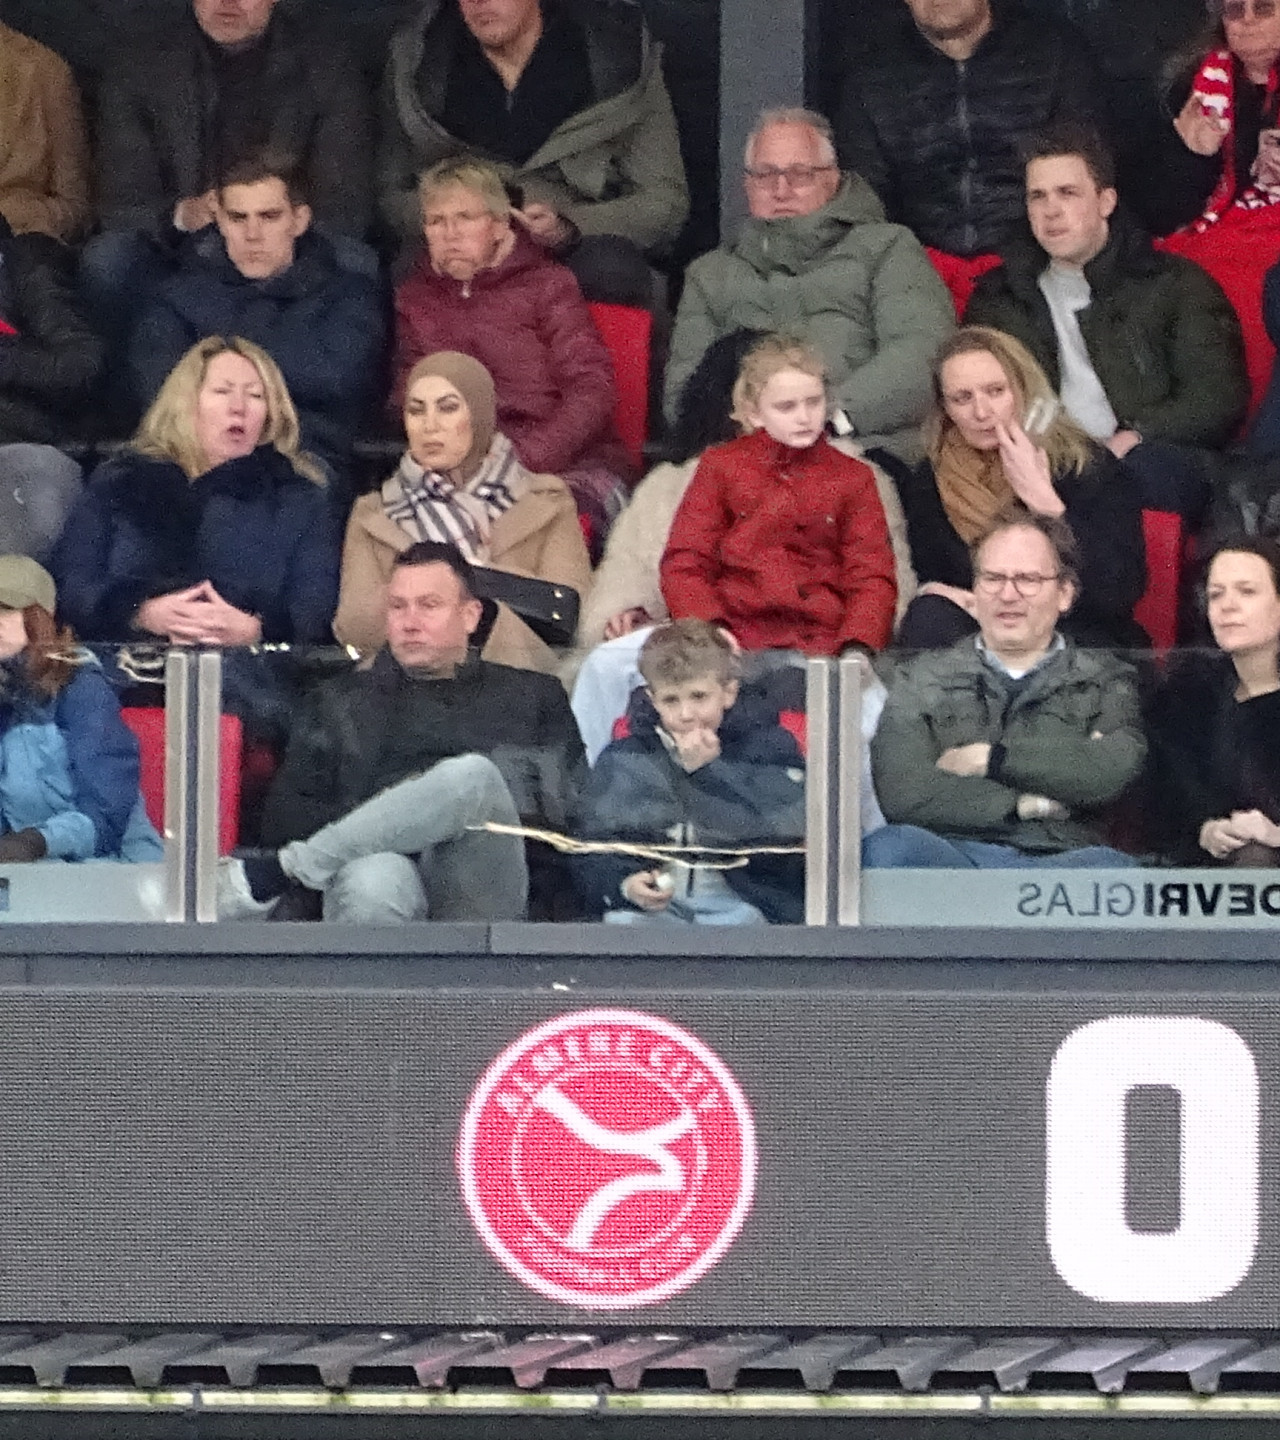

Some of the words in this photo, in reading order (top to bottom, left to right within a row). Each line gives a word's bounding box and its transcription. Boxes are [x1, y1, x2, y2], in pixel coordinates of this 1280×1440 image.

[496, 1030, 633, 1117] ALMERE
[647, 1044, 722, 1112] CITY
[1046, 1016, 1259, 1303] 0
